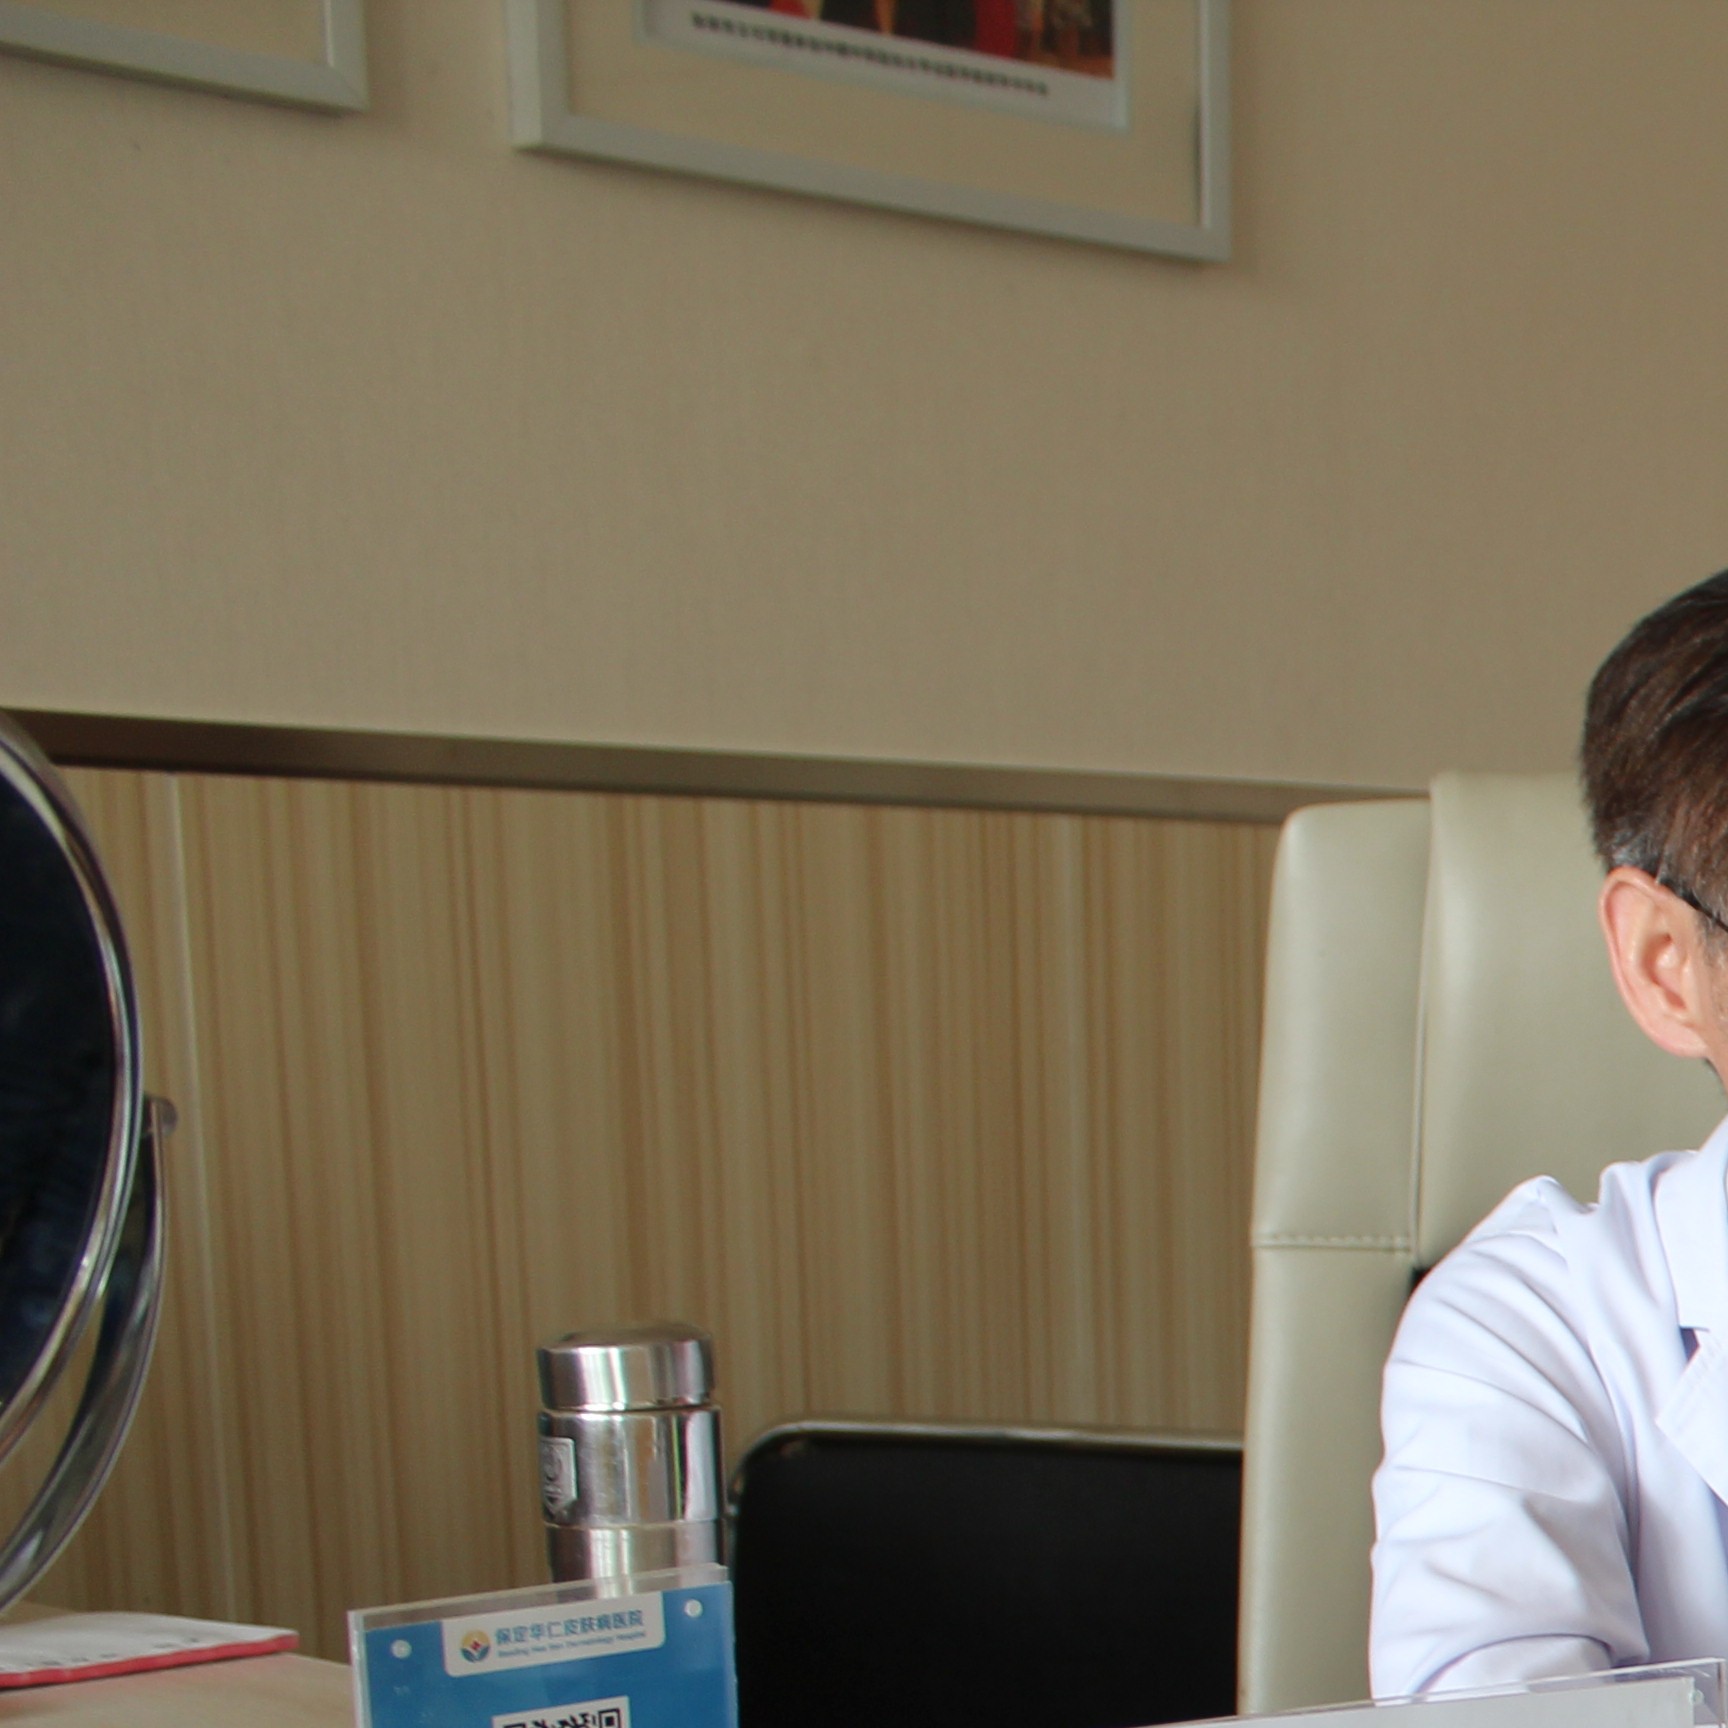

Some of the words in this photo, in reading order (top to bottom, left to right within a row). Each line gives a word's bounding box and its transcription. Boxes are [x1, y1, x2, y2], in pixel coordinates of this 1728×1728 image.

[496, 1610, 643, 1645] 保定华仁皮肤病医院
